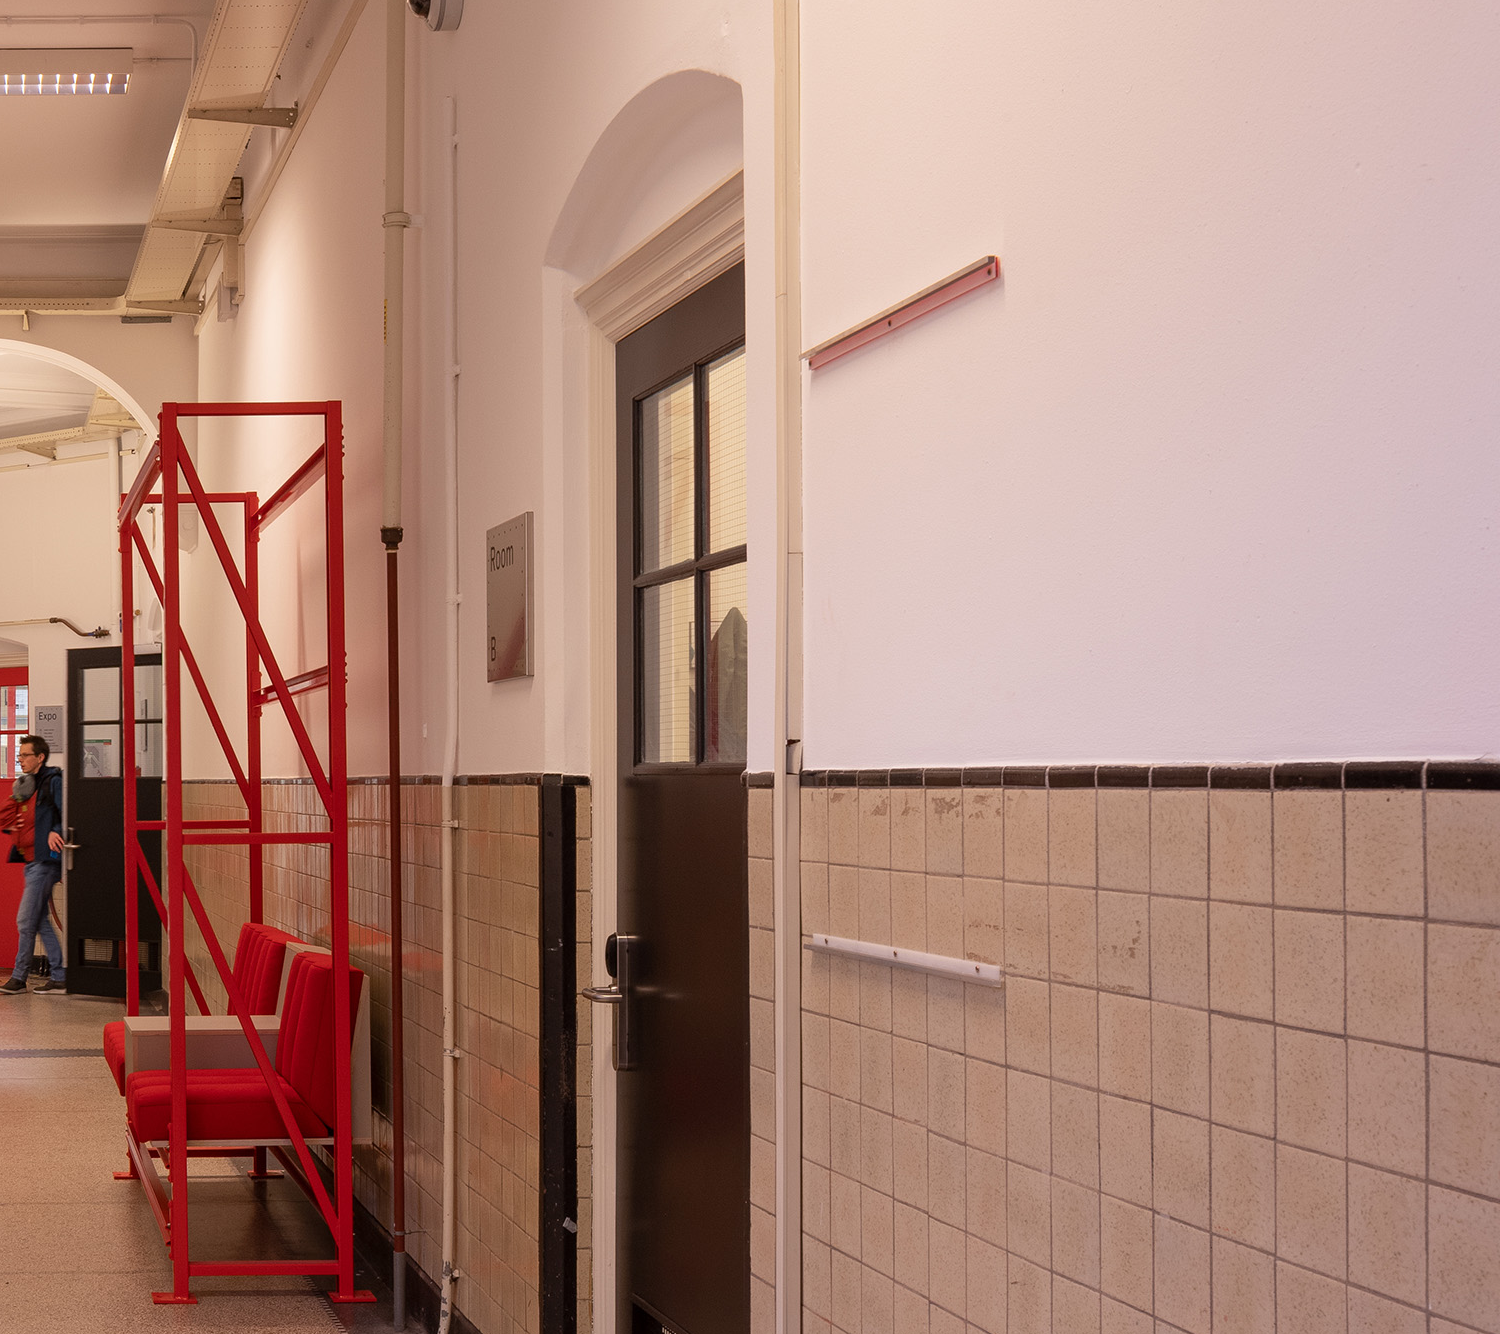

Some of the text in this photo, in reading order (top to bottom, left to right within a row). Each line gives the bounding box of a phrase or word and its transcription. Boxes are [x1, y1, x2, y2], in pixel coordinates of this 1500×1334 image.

[490, 545, 514, 572] Room
[490, 636, 497, 662] B
[38, 711, 57, 722] Expo
